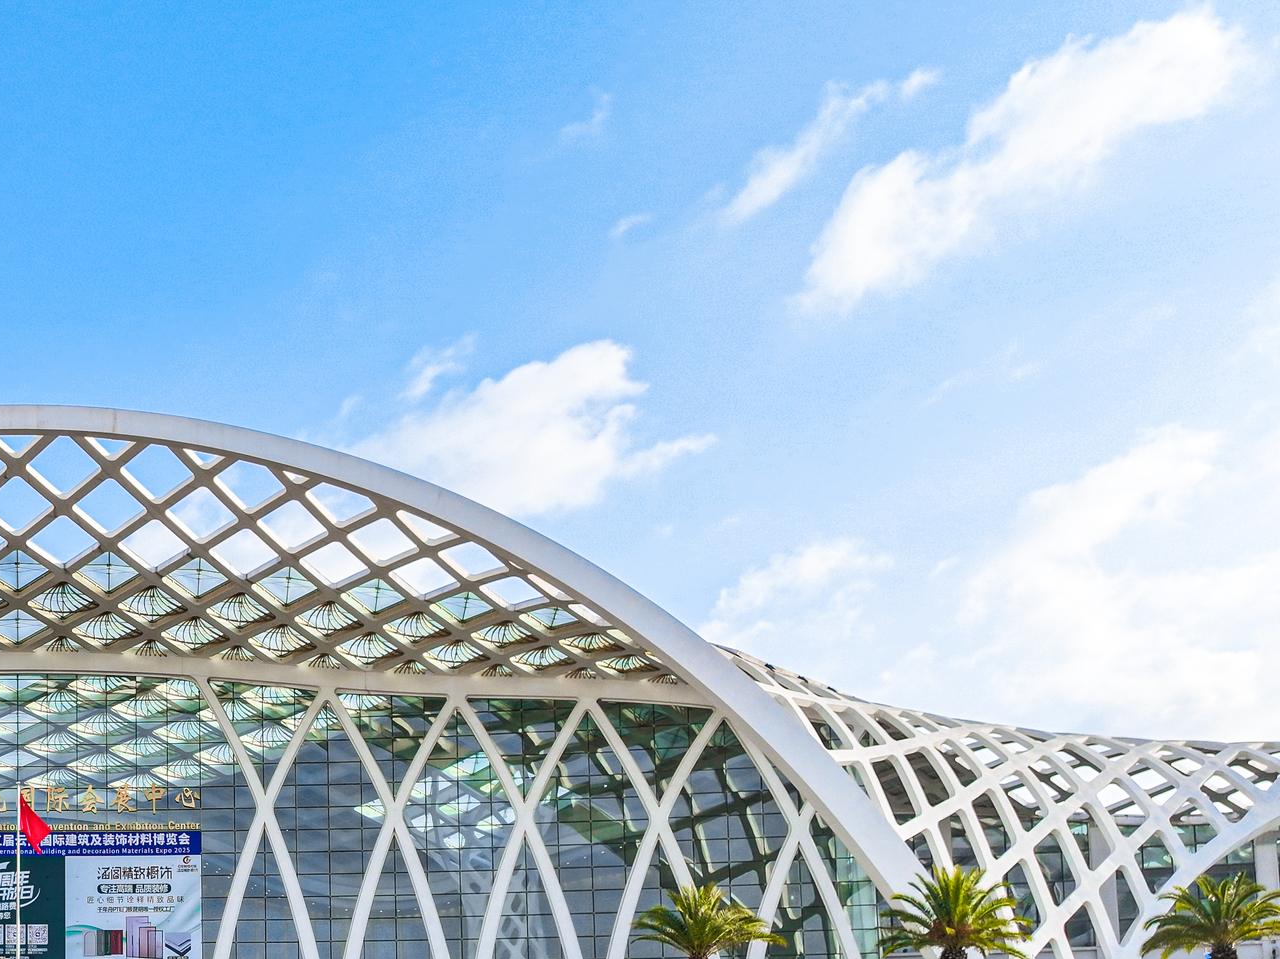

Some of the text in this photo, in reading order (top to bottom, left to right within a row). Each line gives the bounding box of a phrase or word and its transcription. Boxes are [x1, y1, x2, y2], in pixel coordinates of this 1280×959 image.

[93, 822, 108, 831] and
[115, 822, 164, 831] Exhibition
[168, 821, 201, 831] Center
[39, 848, 66, 857] uilding
[155, 848, 173, 857] Expo
